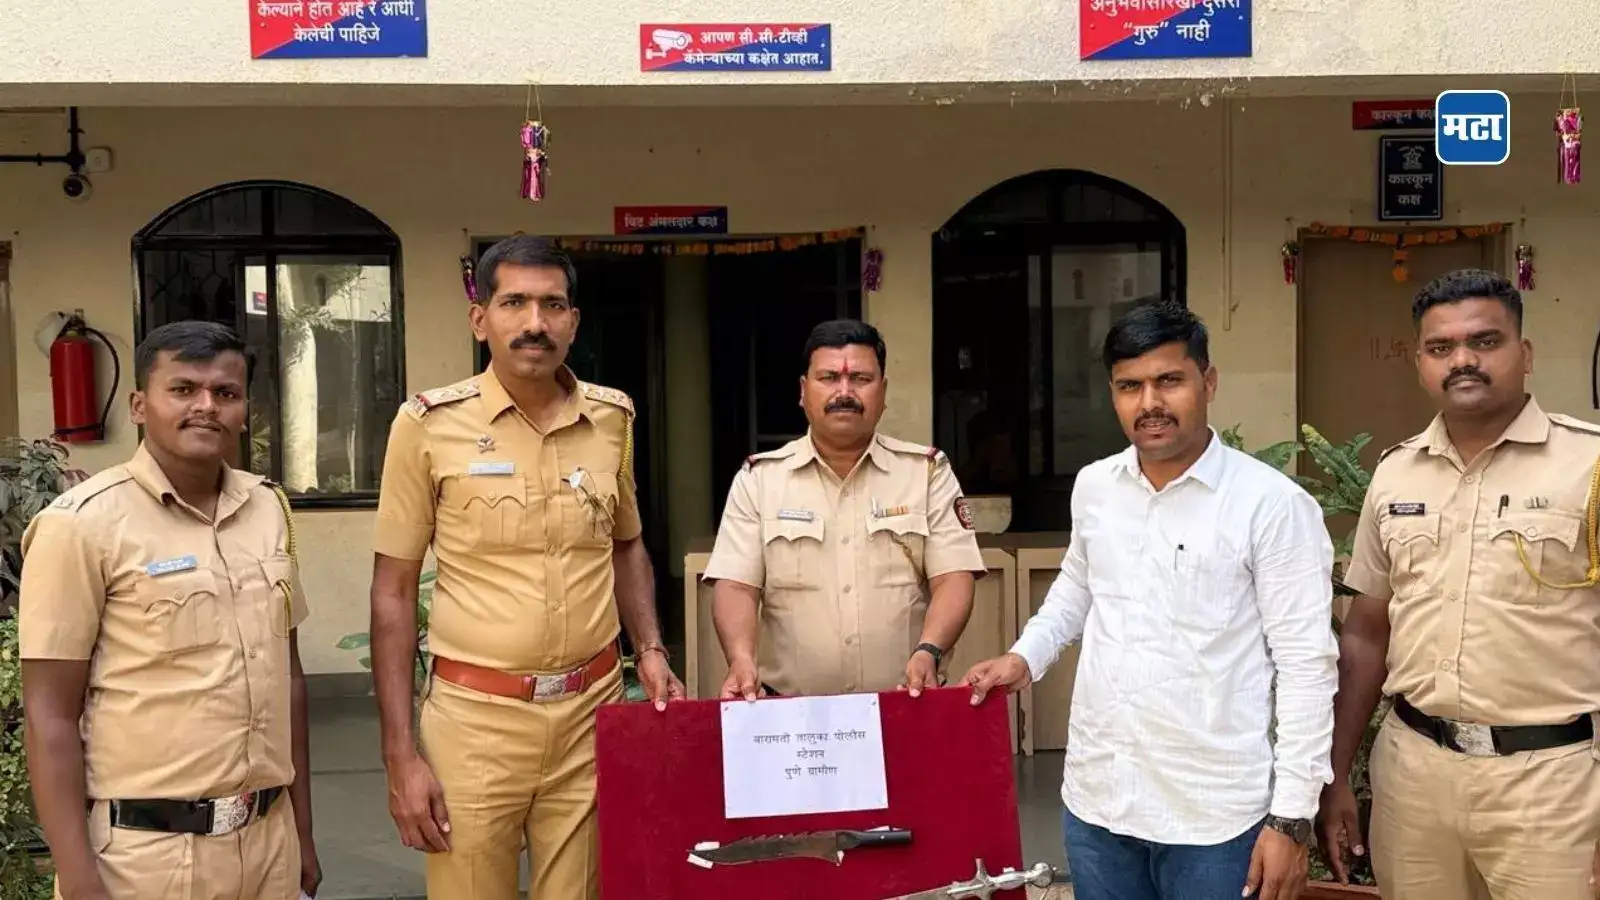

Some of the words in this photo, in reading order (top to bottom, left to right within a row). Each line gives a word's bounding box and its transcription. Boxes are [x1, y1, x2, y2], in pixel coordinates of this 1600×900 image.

[293, 22, 335, 42] केलेची
[338, 22, 381, 44] पाहिजे
[700, 31, 735, 44] आपण
[1176, 19, 1211, 41] नाही
[748, 47, 779, 67] कक्षेत
[783, 52, 824, 66] आहात.
[1388, 173, 1433, 189] कारकून
[1398, 194, 1422, 206] कक्ष
[796, 746, 825, 759] स्टेशन
[784, 764, 802, 780] पुणे
[807, 764, 838, 776] ग्रामीण
